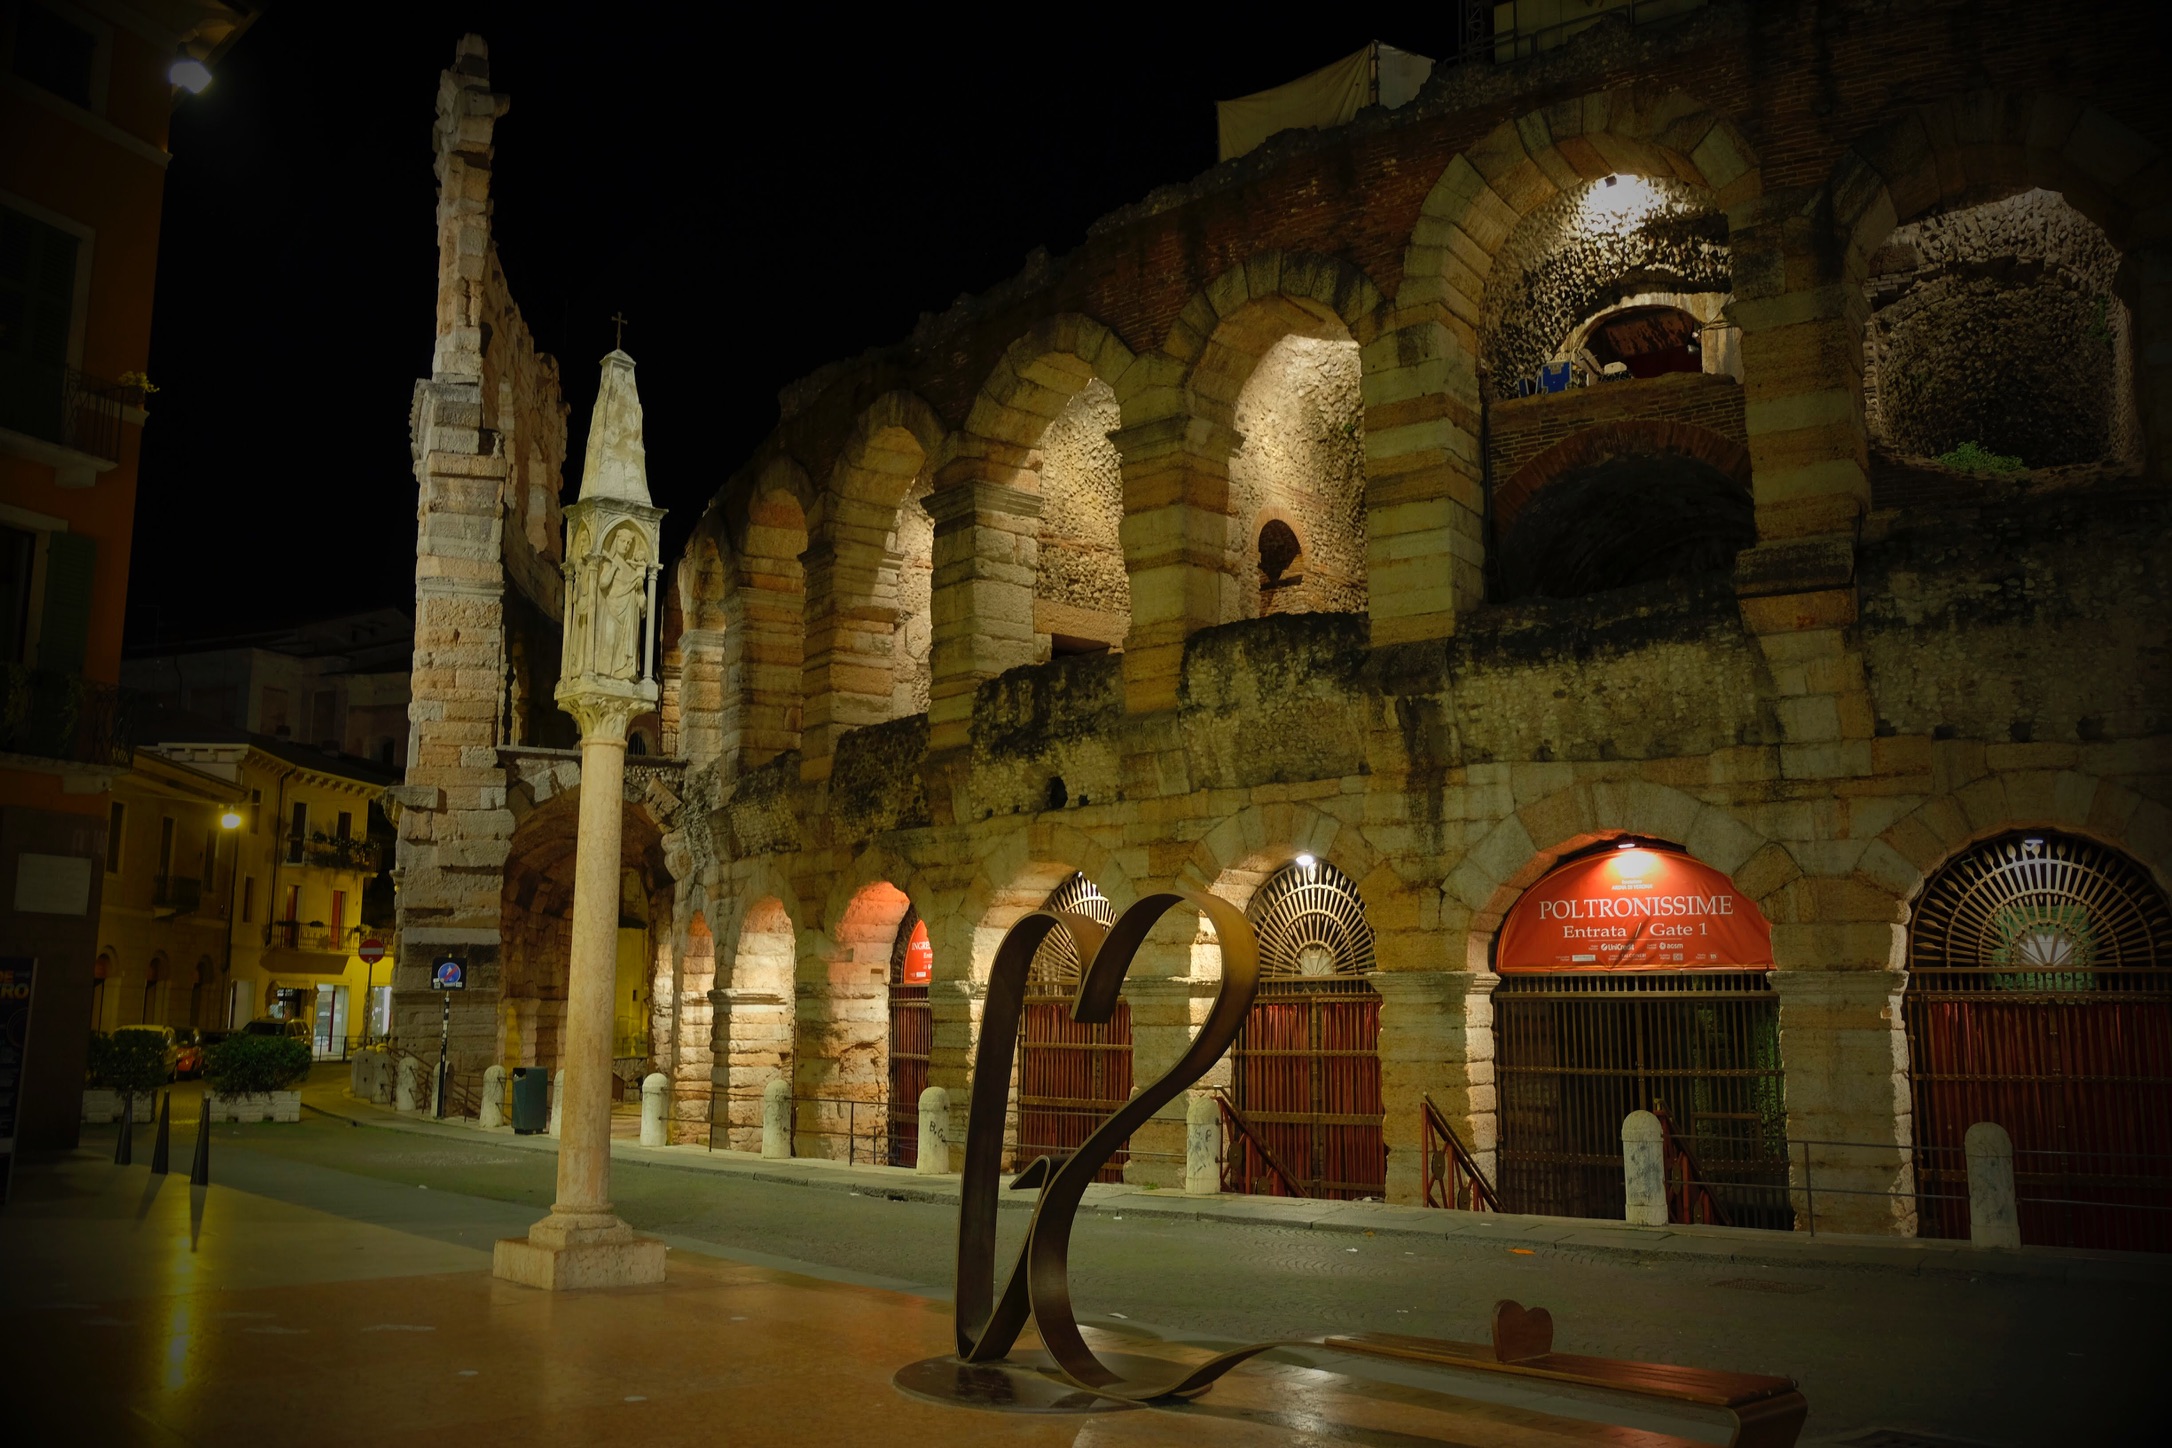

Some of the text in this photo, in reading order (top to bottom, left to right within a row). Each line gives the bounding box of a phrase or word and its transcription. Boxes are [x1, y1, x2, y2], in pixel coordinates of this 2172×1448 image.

[1539, 896, 1734, 920] POLTRONISSIME
[1563, 922, 1708, 939] Entrata / Gate 1
[1608, 943, 1635, 951] UniCredit
